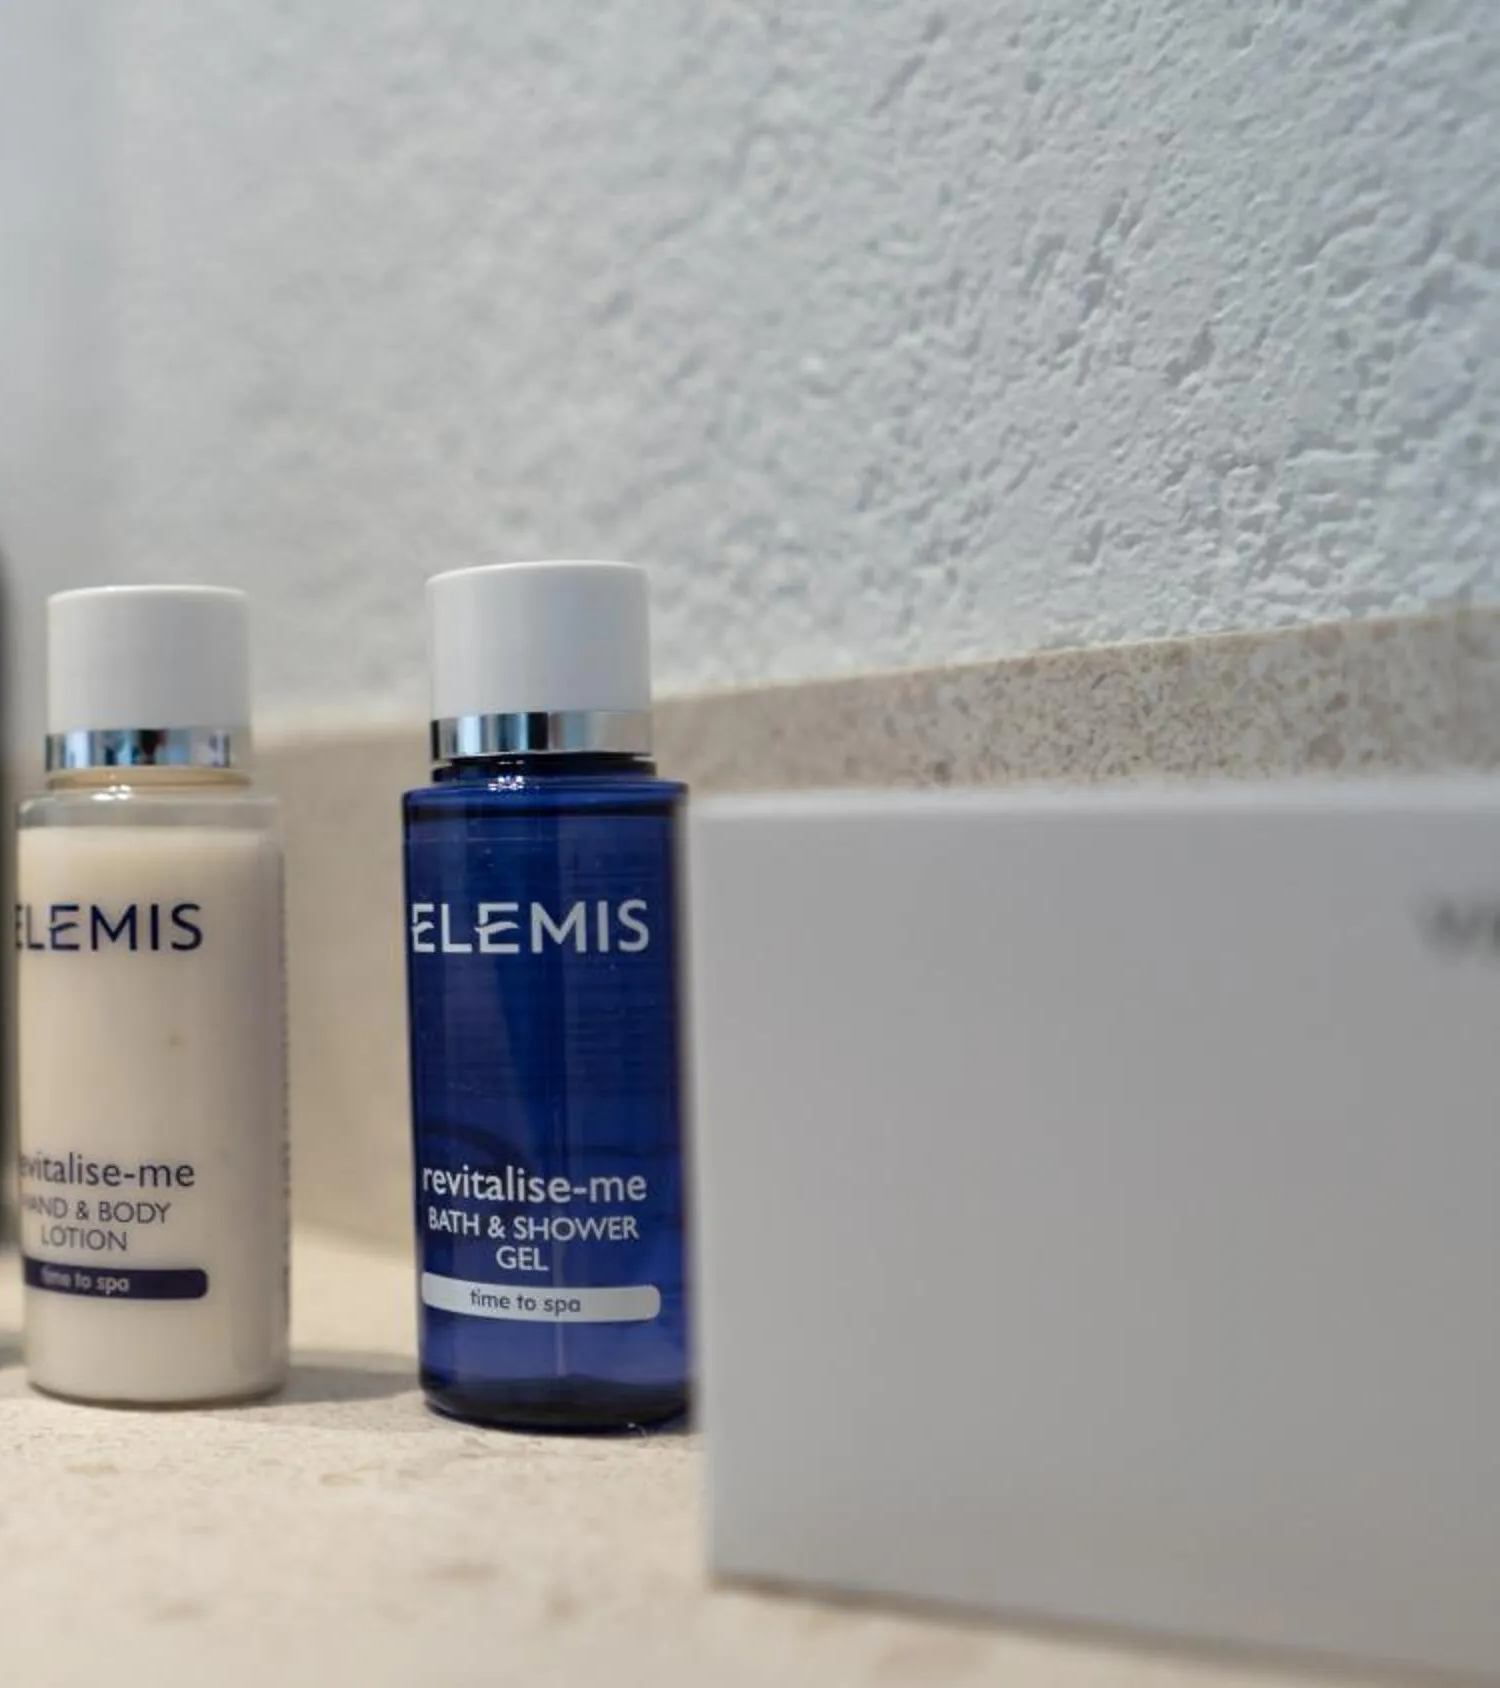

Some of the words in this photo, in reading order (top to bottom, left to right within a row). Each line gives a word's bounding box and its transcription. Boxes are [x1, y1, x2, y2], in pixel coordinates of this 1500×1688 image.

[411, 899, 650, 953] ELEMIS
[19, 1152, 195, 1188] evitalise-me
[423, 1164, 648, 1203] revitalise-me
[21, 1194, 68, 1219] AND
[76, 1200, 90, 1221] &
[99, 1200, 171, 1224] BODY
[428, 1205, 480, 1236] BATH
[487, 1215, 506, 1239] &
[513, 1215, 640, 1241] SHOWER
[41, 1224, 129, 1251] LOTION
[495, 1246, 549, 1272] GEL
[75, 1270, 93, 1290] to
[96, 1275, 131, 1297] spa
[470, 1287, 511, 1310] time
[516, 1293, 538, 1313] to
[543, 1296, 582, 1318] spa
